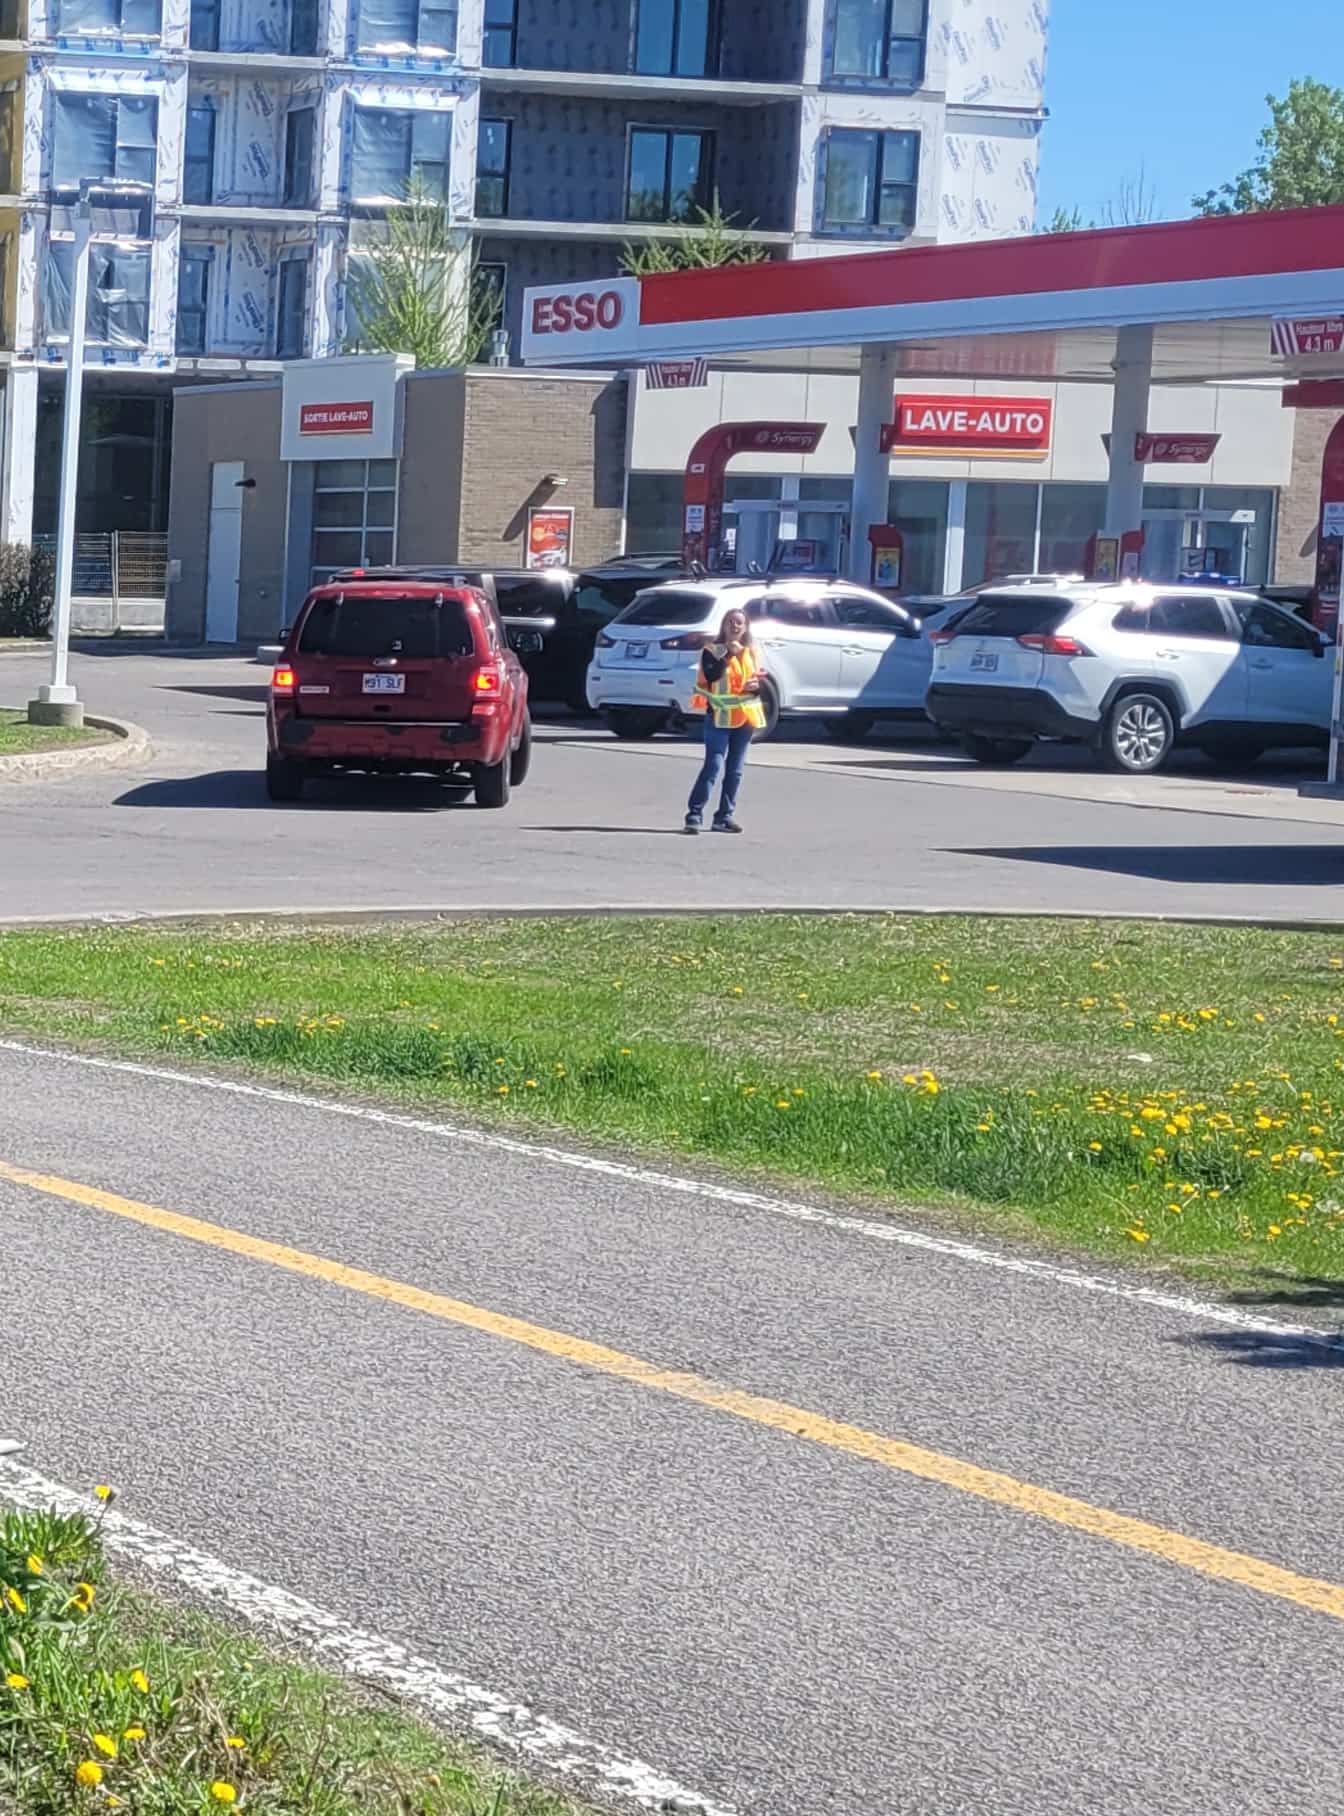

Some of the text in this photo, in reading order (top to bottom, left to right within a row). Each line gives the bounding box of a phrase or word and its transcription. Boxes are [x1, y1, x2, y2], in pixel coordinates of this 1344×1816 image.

[531, 290, 623, 334] ESSO
[303, 410, 369, 424] SORTIE LAVE-AUTO
[905, 409, 1045, 434] LAVE-AUTO
[772, 431, 814, 446] Synergy
